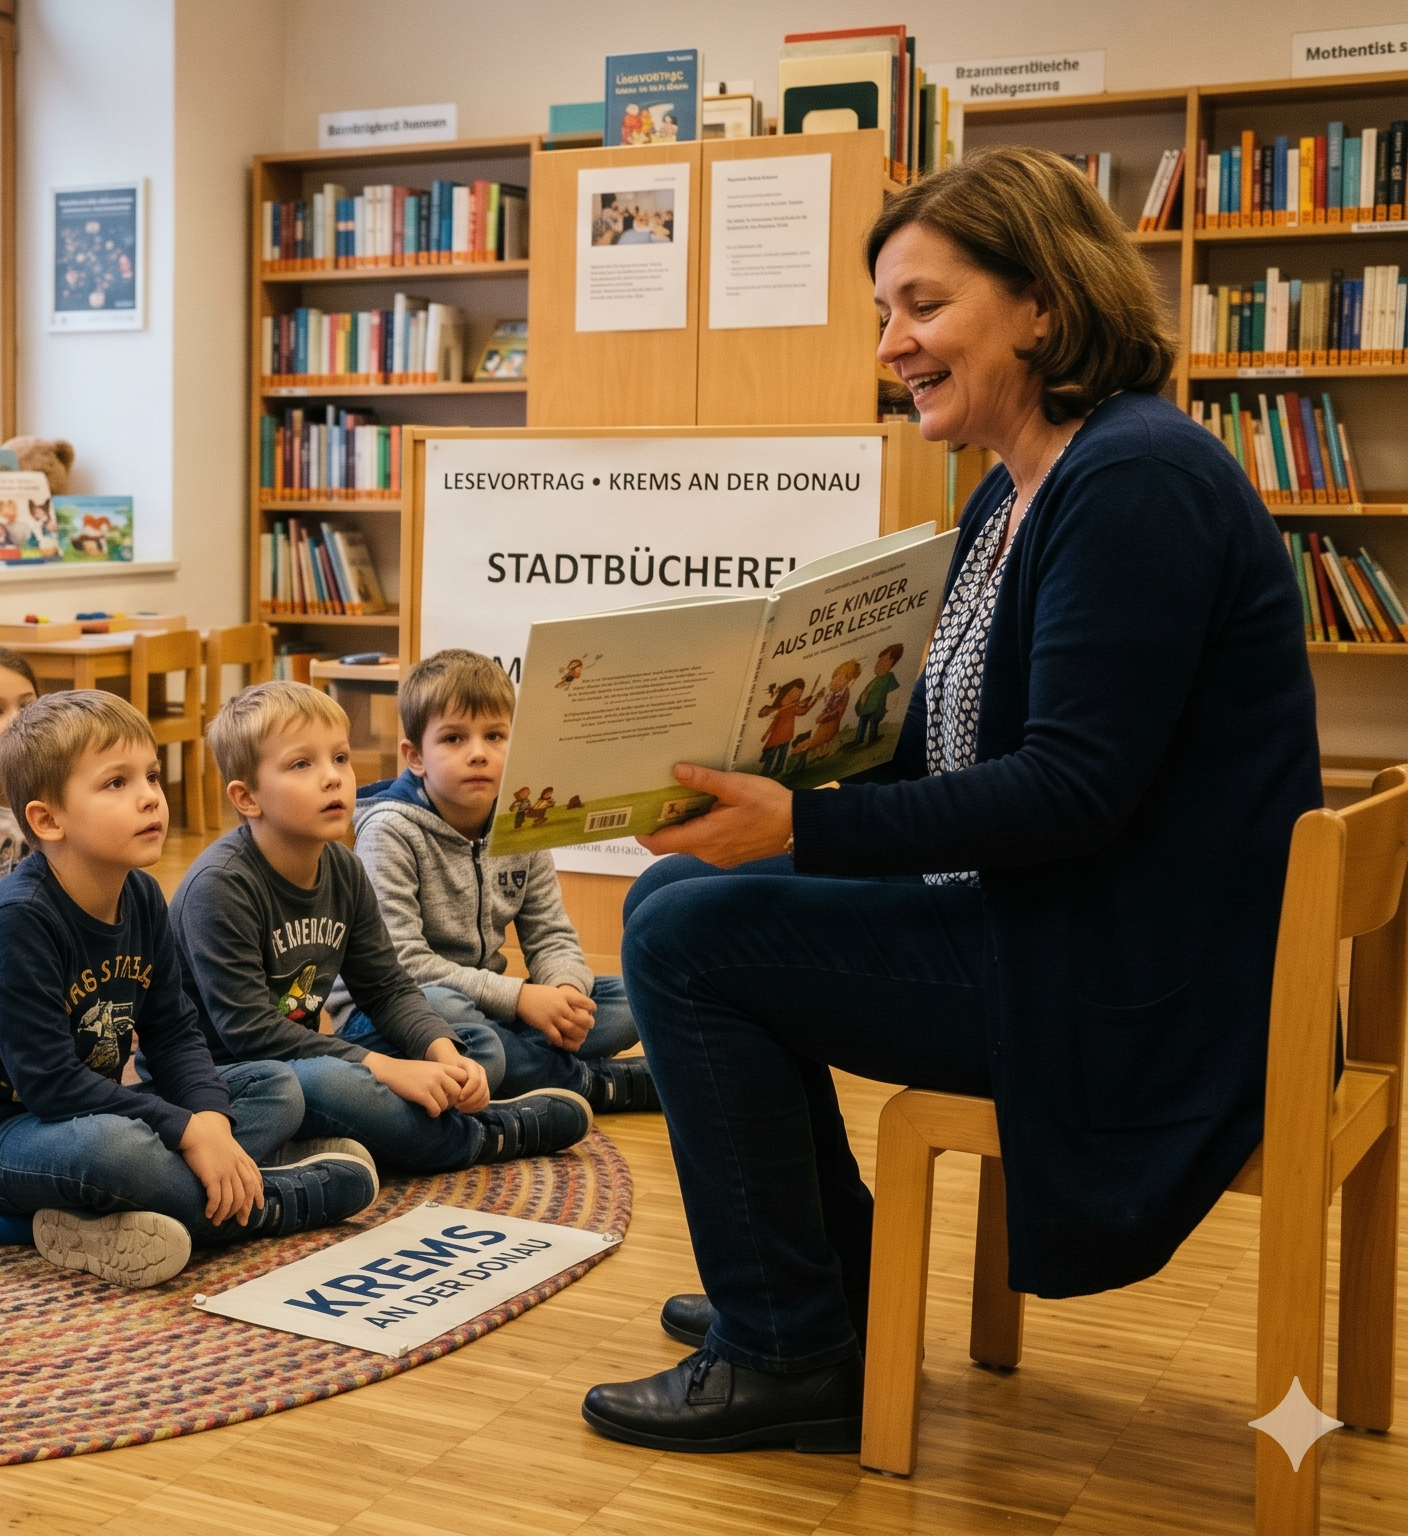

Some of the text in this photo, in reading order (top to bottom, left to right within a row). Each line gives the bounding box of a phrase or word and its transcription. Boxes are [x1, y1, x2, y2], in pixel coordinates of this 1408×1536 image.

[444, 473, 584, 490] LESEVORTRAG
[609, 473, 682, 490] KREMS
[688, 473, 719, 490] AN
[727, 473, 769, 490] DER
[777, 473, 860, 491] DONAU
[772, 632, 808, 659] AUS
[811, 620, 844, 646] DER
[847, 590, 929, 633] LESEECKE
[808, 601, 838, 626] DIE
[842, 578, 908, 614] KINDER
[283, 1225, 507, 1318] KREMS
[362, 1238, 553, 1330] AN DER DONAU
